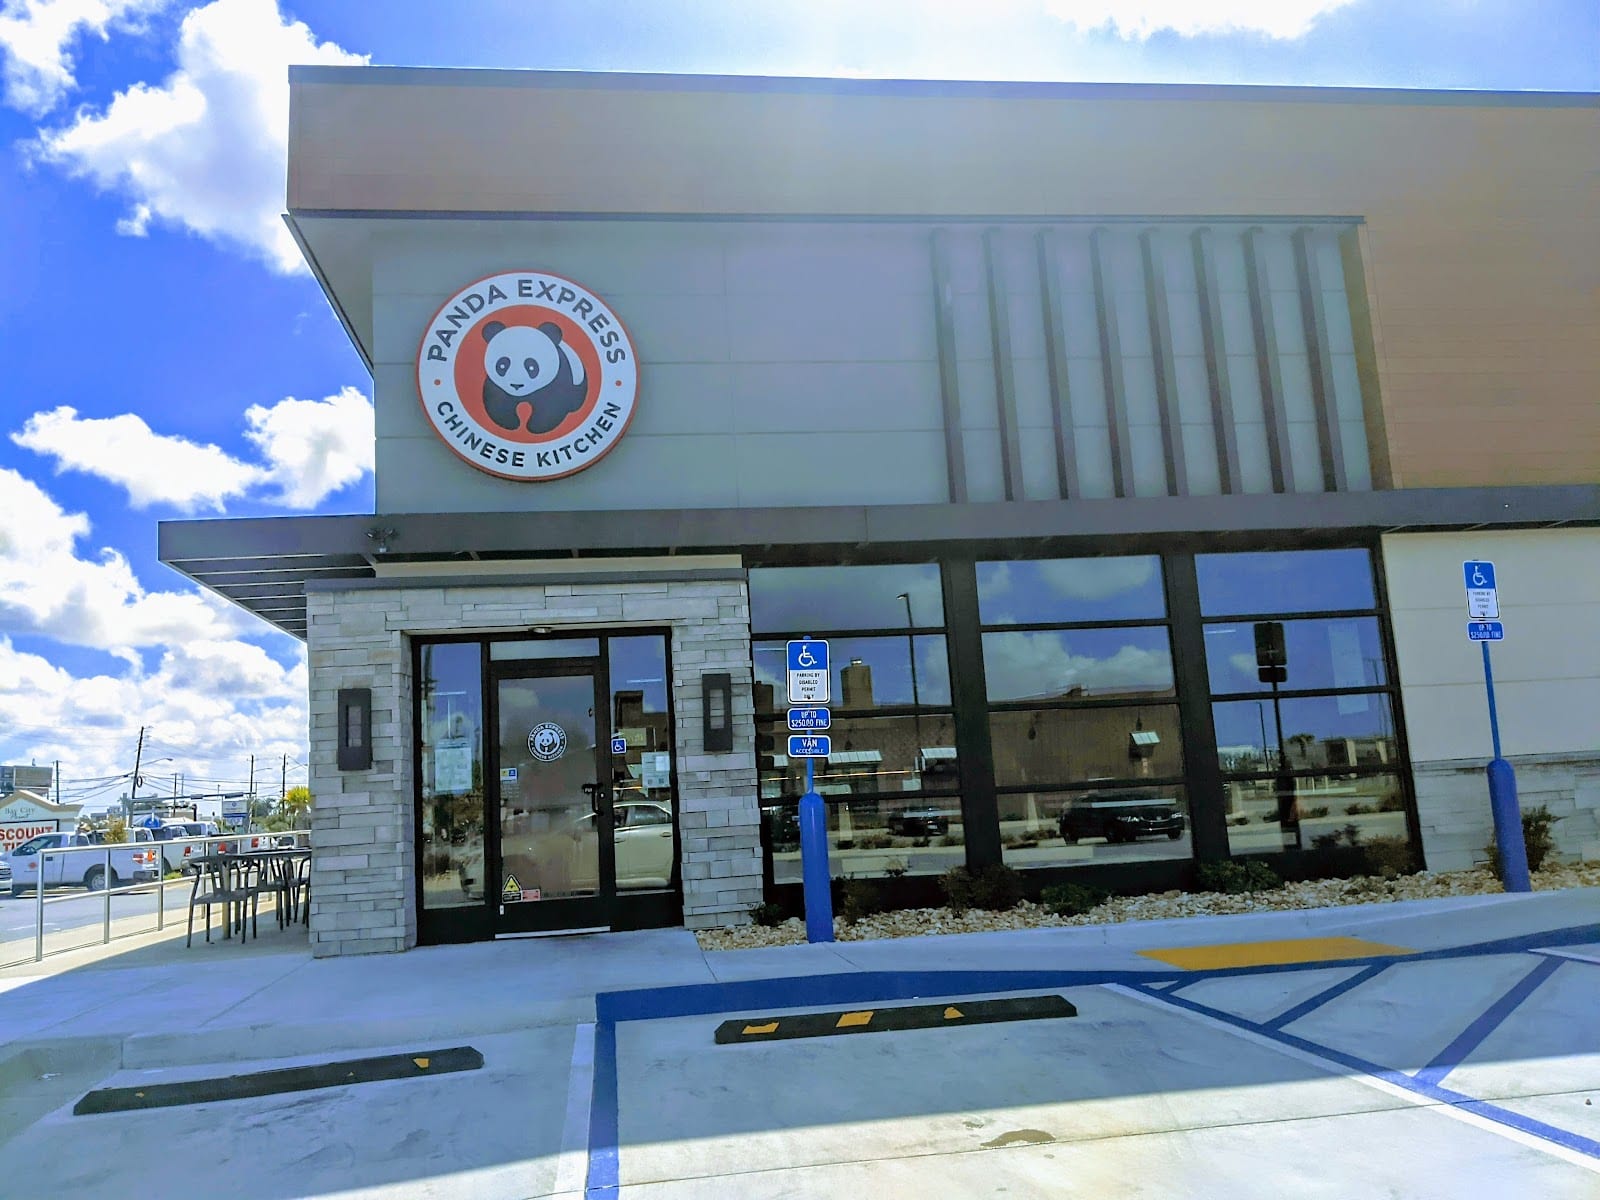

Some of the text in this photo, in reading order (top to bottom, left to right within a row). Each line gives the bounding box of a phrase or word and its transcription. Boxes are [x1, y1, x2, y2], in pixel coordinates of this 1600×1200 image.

[427, 279, 626, 364] PANDA EXPRESS
[437, 401, 622, 468] CHINESE KITCHEN
[801, 710, 817, 719] UP TO
[815, 718, 828, 727] FINE
[801, 738, 818, 748] VAN
